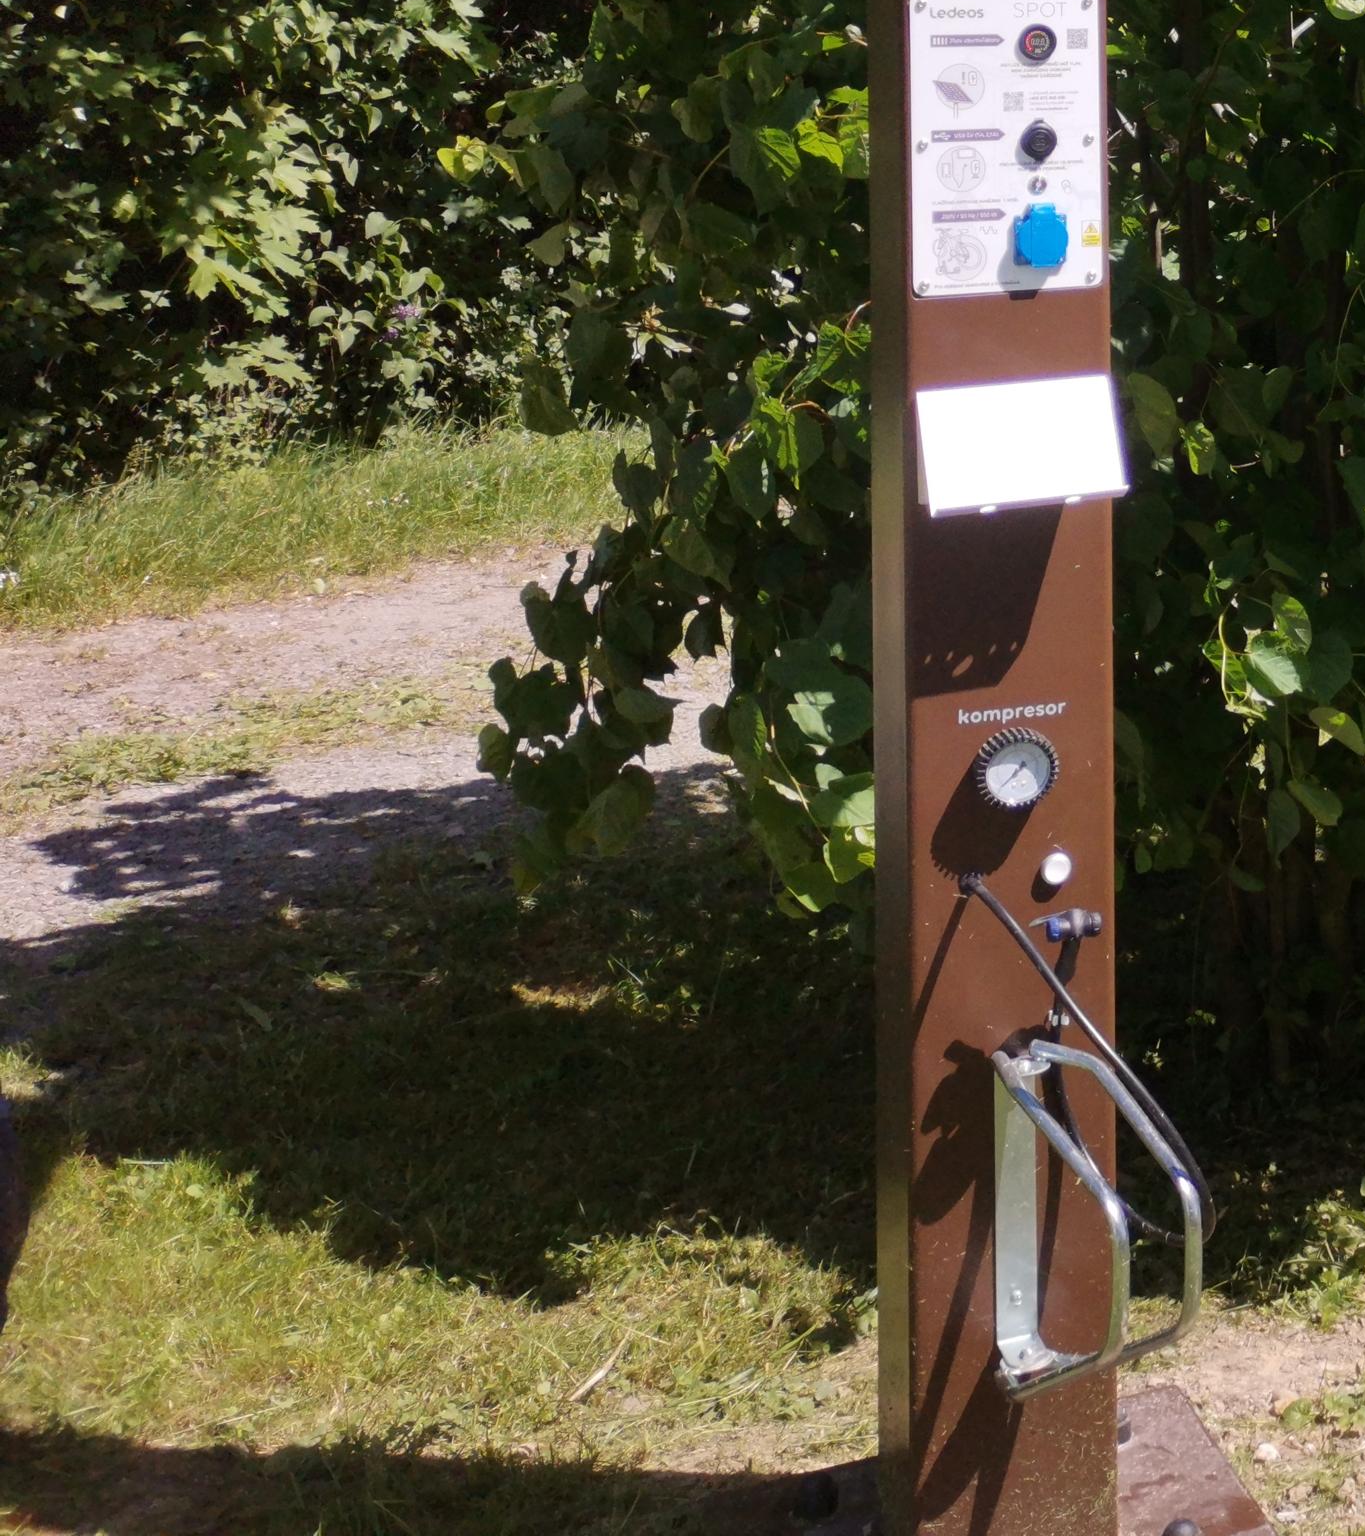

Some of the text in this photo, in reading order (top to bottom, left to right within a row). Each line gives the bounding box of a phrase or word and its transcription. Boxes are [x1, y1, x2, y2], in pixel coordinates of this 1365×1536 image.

[929, 1, 1067, 19] Ledeos SPOT
[957, 701, 1067, 725] kompresor
